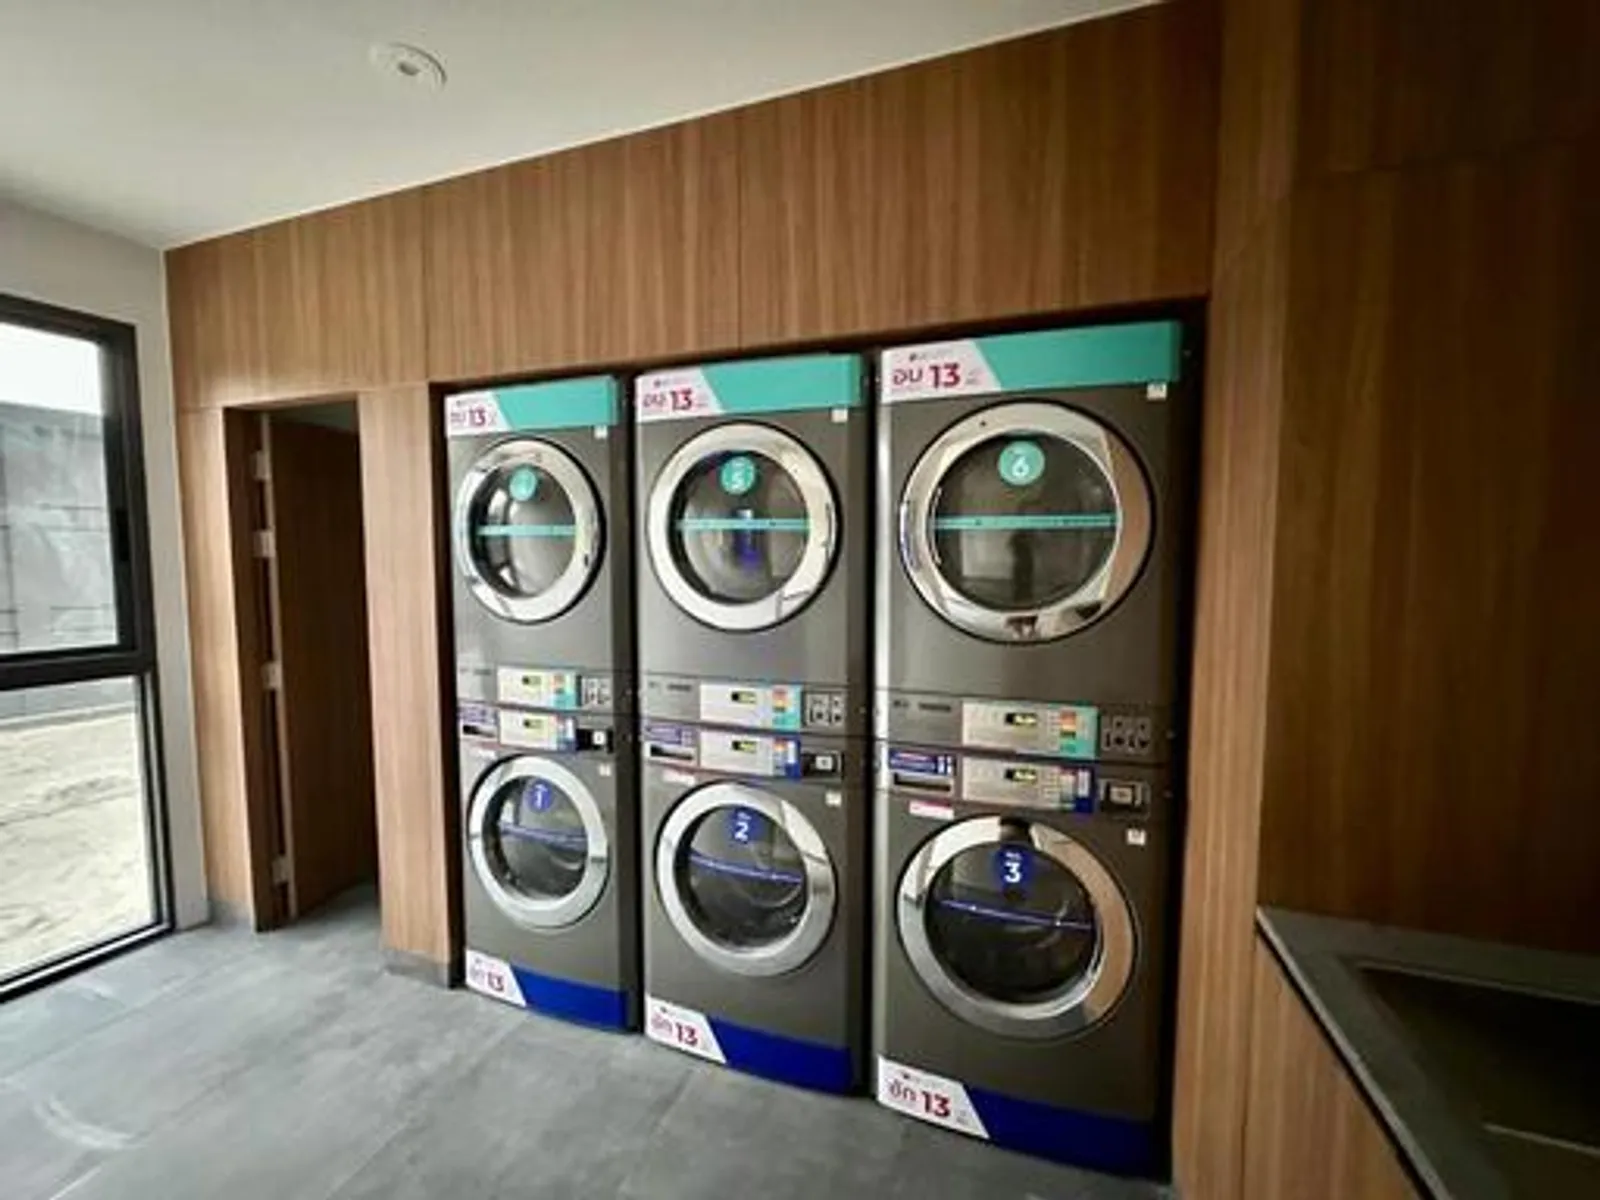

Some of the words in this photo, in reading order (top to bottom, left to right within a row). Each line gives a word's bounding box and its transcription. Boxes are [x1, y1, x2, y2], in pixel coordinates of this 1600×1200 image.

[928, 362, 961, 389] 13
[669, 388, 693, 411] 13
[468, 406, 486, 427] 13
[1011, 455, 1030, 478] 6
[734, 821, 749, 841] 2
[1003, 861, 1022, 883] 3
[487, 971, 505, 992] 13
[675, 1022, 698, 1047] 13
[921, 1090, 951, 1117] 13
